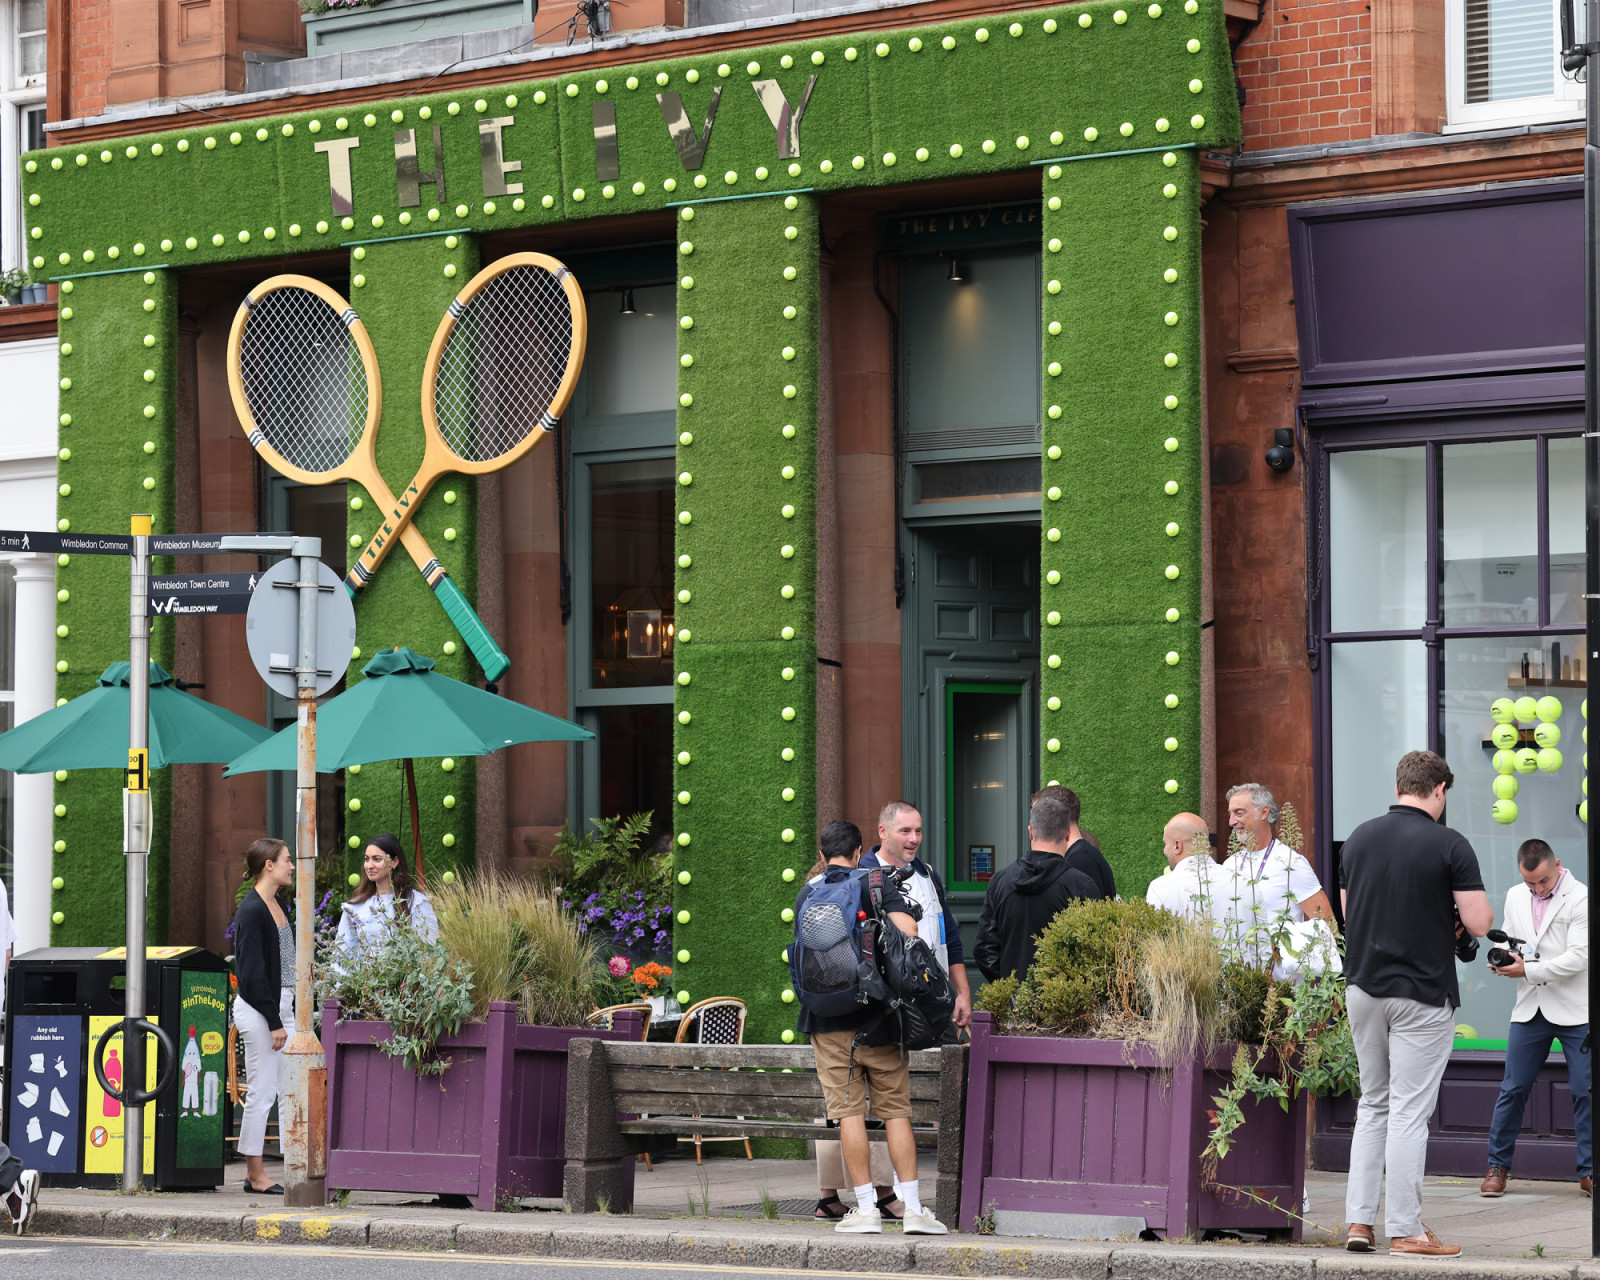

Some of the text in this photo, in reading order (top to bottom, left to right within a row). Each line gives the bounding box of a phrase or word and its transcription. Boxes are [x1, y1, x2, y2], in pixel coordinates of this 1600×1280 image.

[314, 74, 818, 217] THE IVY
[899, 208, 1040, 235] THE IVY CAF
[366, 481, 418, 558] THE IVY
[1, 536, 20, 546] 5 min
[61, 538, 128, 550] Wimbledon Common
[153, 540, 220, 550] Wimbledon Museum
[152, 579, 230, 590] Wimbledon Town Centre
[172, 605, 206, 613] WIMBLEDON
[191, 986, 216, 994] Wimbledon
[182, 995, 225, 1012] #InTheLoop
